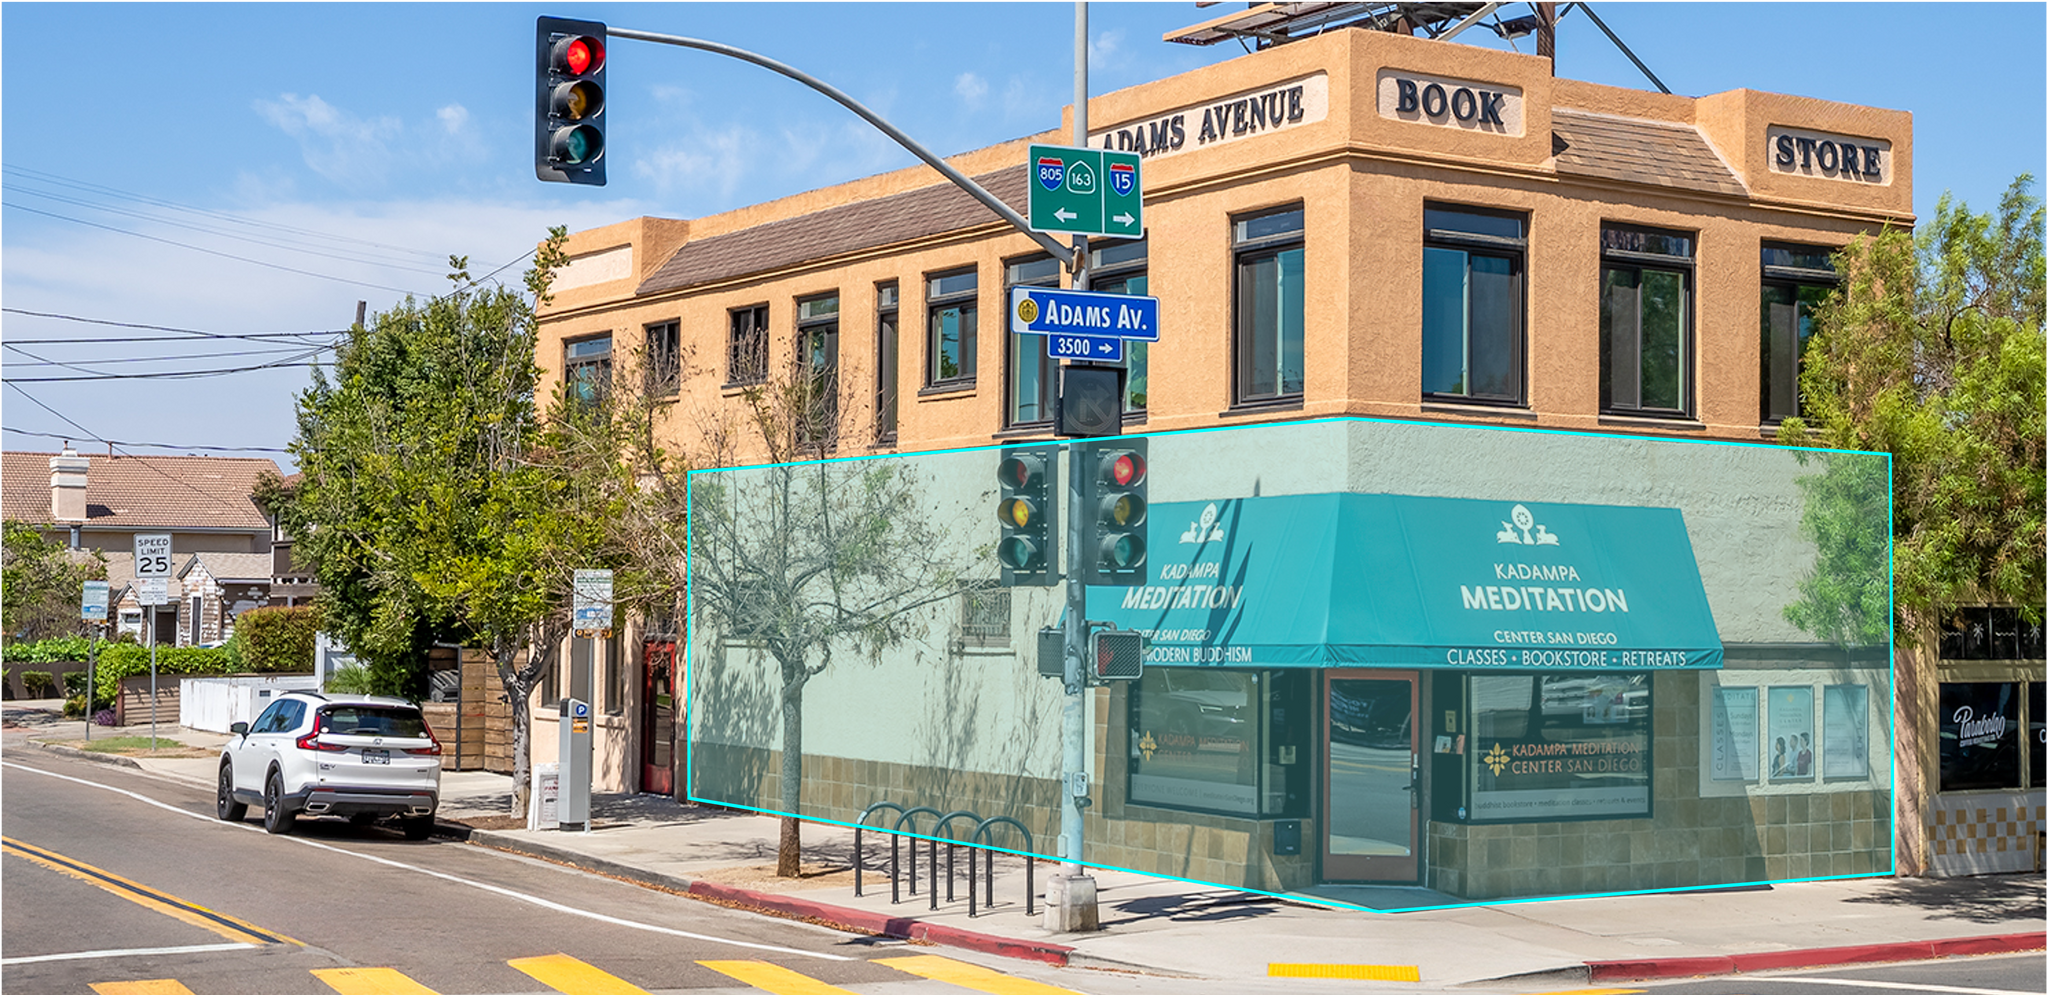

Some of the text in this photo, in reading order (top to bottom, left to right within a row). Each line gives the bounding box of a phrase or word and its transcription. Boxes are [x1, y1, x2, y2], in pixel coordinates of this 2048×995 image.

[1395, 79, 1504, 126] BOOK
[1103, 85, 1305, 154] ADAMS AVENUE
[1776, 135, 1881, 176] STORE
[1040, 167, 1063, 181] 805
[1071, 173, 1092, 186] 163
[1115, 173, 1131, 189] 15
[1045, 299, 1111, 328] ADAMS
[1057, 338, 1091, 355] 3500
[138, 539, 169, 547] SPEED
[140, 557, 168, 573] 25
[1160, 562, 1220, 580] KADAMPA
[1493, 563, 1581, 582] KADAMPA
[1121, 585, 1243, 610] MEDITATION
[1460, 585, 1629, 613] MEDITATION
[1160, 629, 1180, 641] SAN
[1180, 629, 1212, 642] DIEGO
[1494, 630, 1618, 645] CENTER SAN DIEGO
[1193, 646, 1252, 663] BUDDHISM
[1447, 649, 1687, 667] CLASSES BOOKSTORE RETREATS
[1157, 732, 1197, 747] KADAMPA
[1716, 712, 1724, 771] CLASSES
[1512, 742, 1639, 757] KADAMPA MEDITATION
[1511, 757, 1640, 774] CENTER SAN DIEGO
